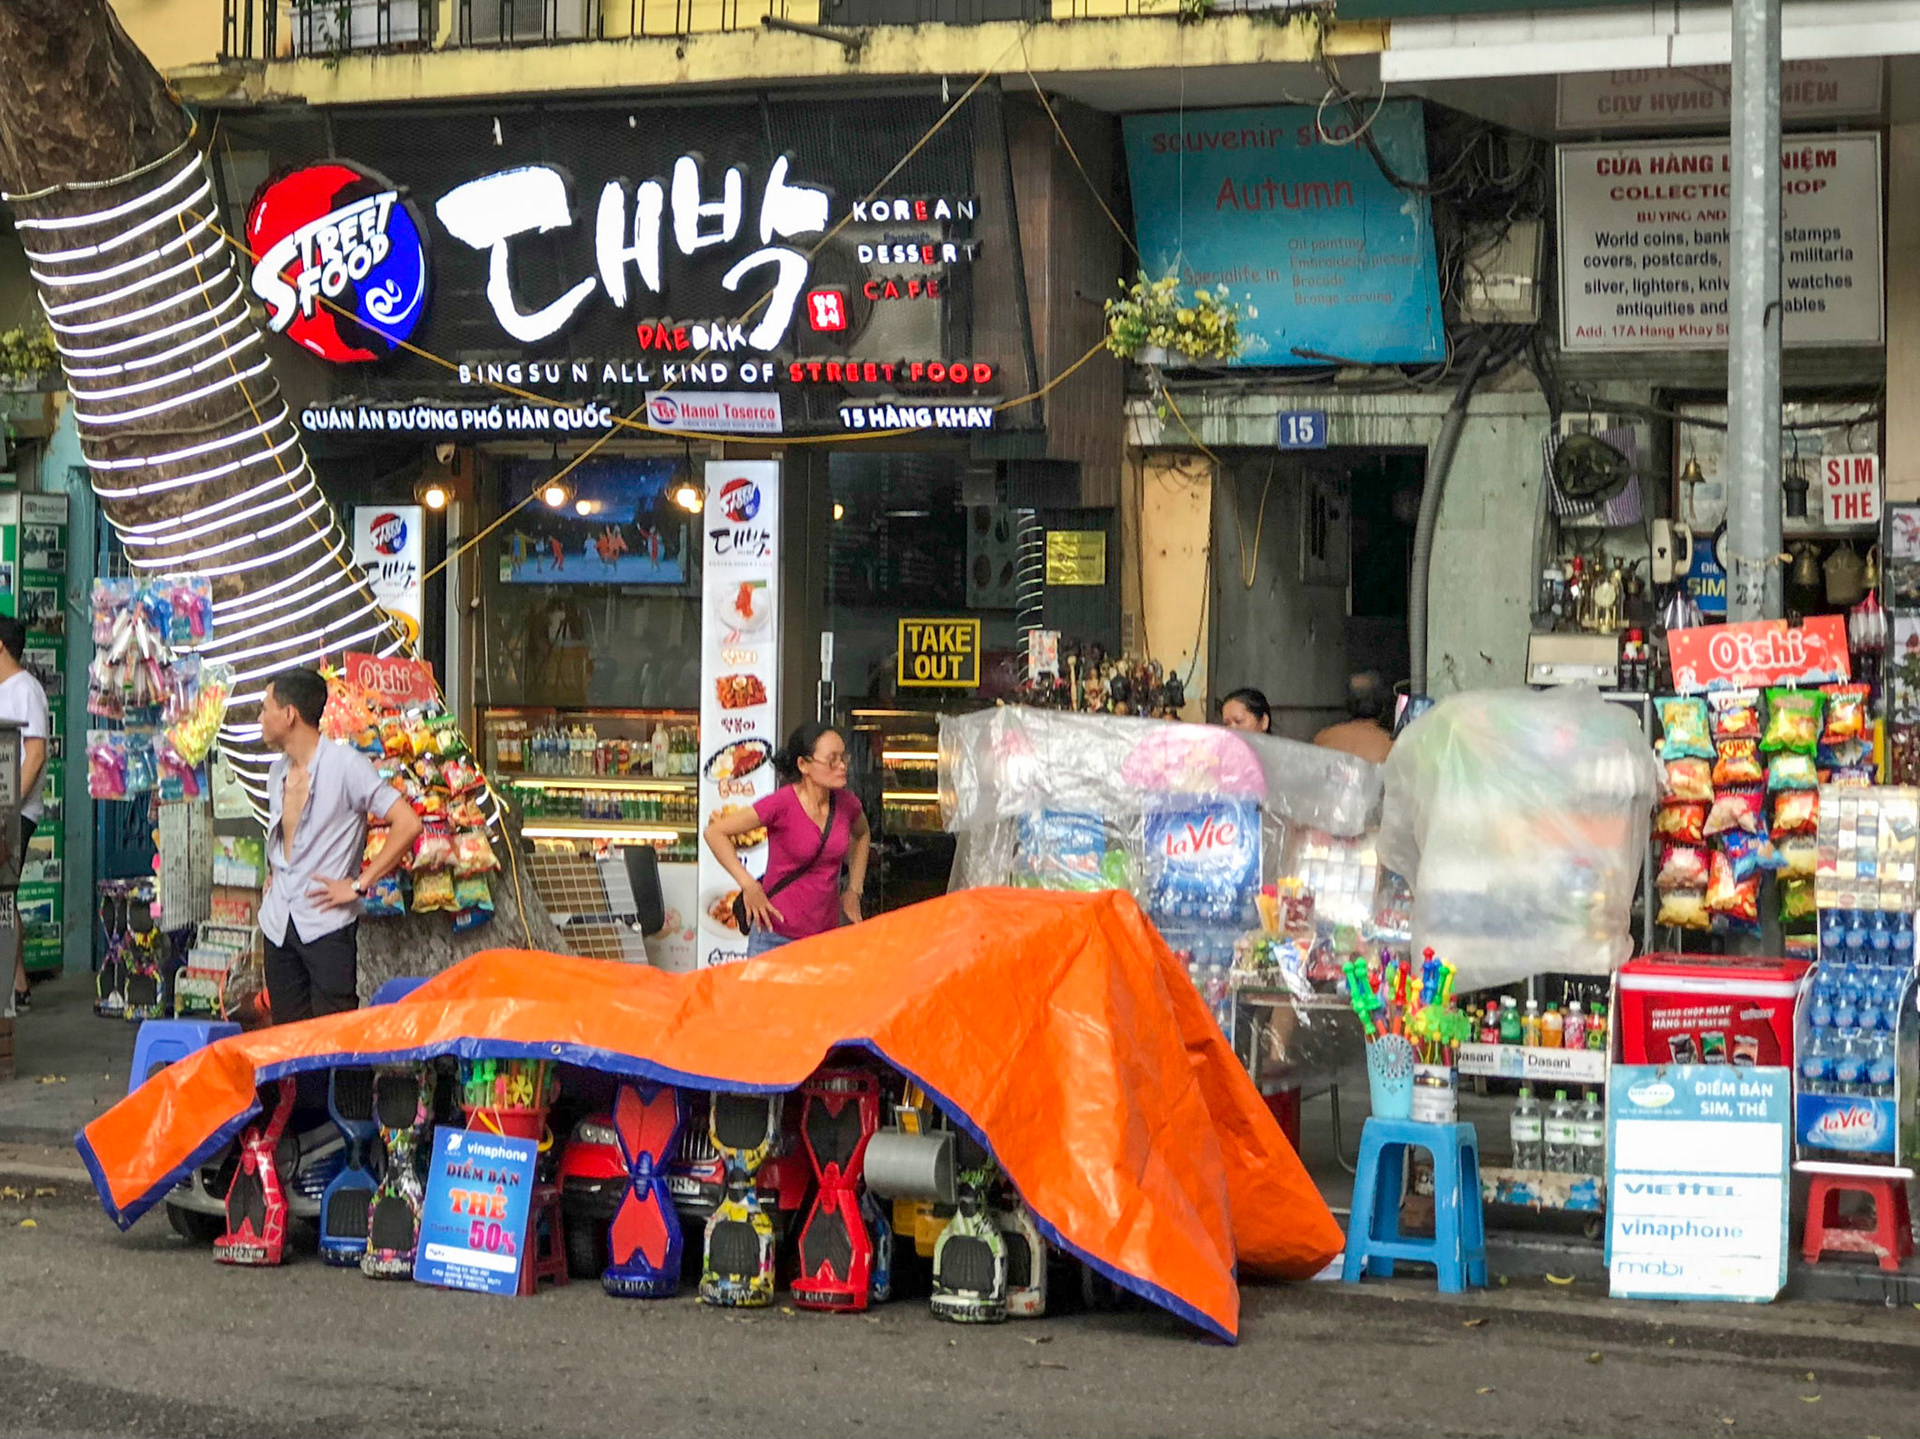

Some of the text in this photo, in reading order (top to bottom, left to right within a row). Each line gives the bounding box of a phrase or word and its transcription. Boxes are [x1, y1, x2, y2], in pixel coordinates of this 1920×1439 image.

[1152, 125, 1282, 154] souvenir
[1596, 151, 1642, 176] CỬA
[1650, 151, 1714, 175] HÀNG
[1215, 176, 1354, 212] Autumn
[1610, 180, 1826, 201] COLLECTIO HOP
[853, 199, 974, 222] KOREAN
[1637, 209, 1727, 224] BUYING AND
[1595, 230, 1639, 249] World
[1644, 229, 1690, 247] coins,
[1784, 226, 1842, 244] stamps
[252, 190, 398, 334] STREET
[857, 243, 979, 265] DESSERT
[1584, 247, 1854, 270] covers, postcards, militaria
[296, 233, 390, 318] FOOD
[1265, 266, 1280, 283] in
[1585, 278, 1629, 296] silver,
[1633, 275, 1694, 297] lighters,
[1787, 273, 1853, 290] watches
[863, 280, 940, 301] CAFE
[1616, 299, 1695, 319] antiquities
[1700, 298, 1728, 315] and
[637, 320, 747, 352] DAEBAK
[1612, 324, 1636, 338] 17A
[1640, 324, 1675, 338] Hang
[1679, 322, 1713, 337] Khay
[458, 361, 992, 385] BINGSU N ALL KIND OF STREET FOOD
[302, 401, 614, 432] QUÁN ĂN ĐƯỜNG PHỐ HÀN QUỐC
[681, 402, 719, 419] Hanoi
[723, 402, 776, 421] Toserco
[840, 403, 993, 429] 15 HÀNG KHAY
[1288, 415, 1314, 444] 15
[1827, 457, 1874, 487] SIM
[1688, 577, 1726, 598] SIM
[907, 625, 972, 653] TAKE
[1709, 630, 1807, 674] Oishi
[358, 659, 414, 695] Oishi
[913, 654, 964, 680] OUT
[1528, 1053, 1571, 1069] Dasani
[1739, 1078, 1774, 1098] BÁN
[1700, 1101, 1733, 1117] SIM,
[467, 1141, 528, 1163] vinaphone
[488, 1166, 521, 1187] BÁN
[468, 1219, 517, 1257] 50%
[1620, 1218, 1743, 1241] vinaphone
[1617, 1260, 1684, 1276] mobi
